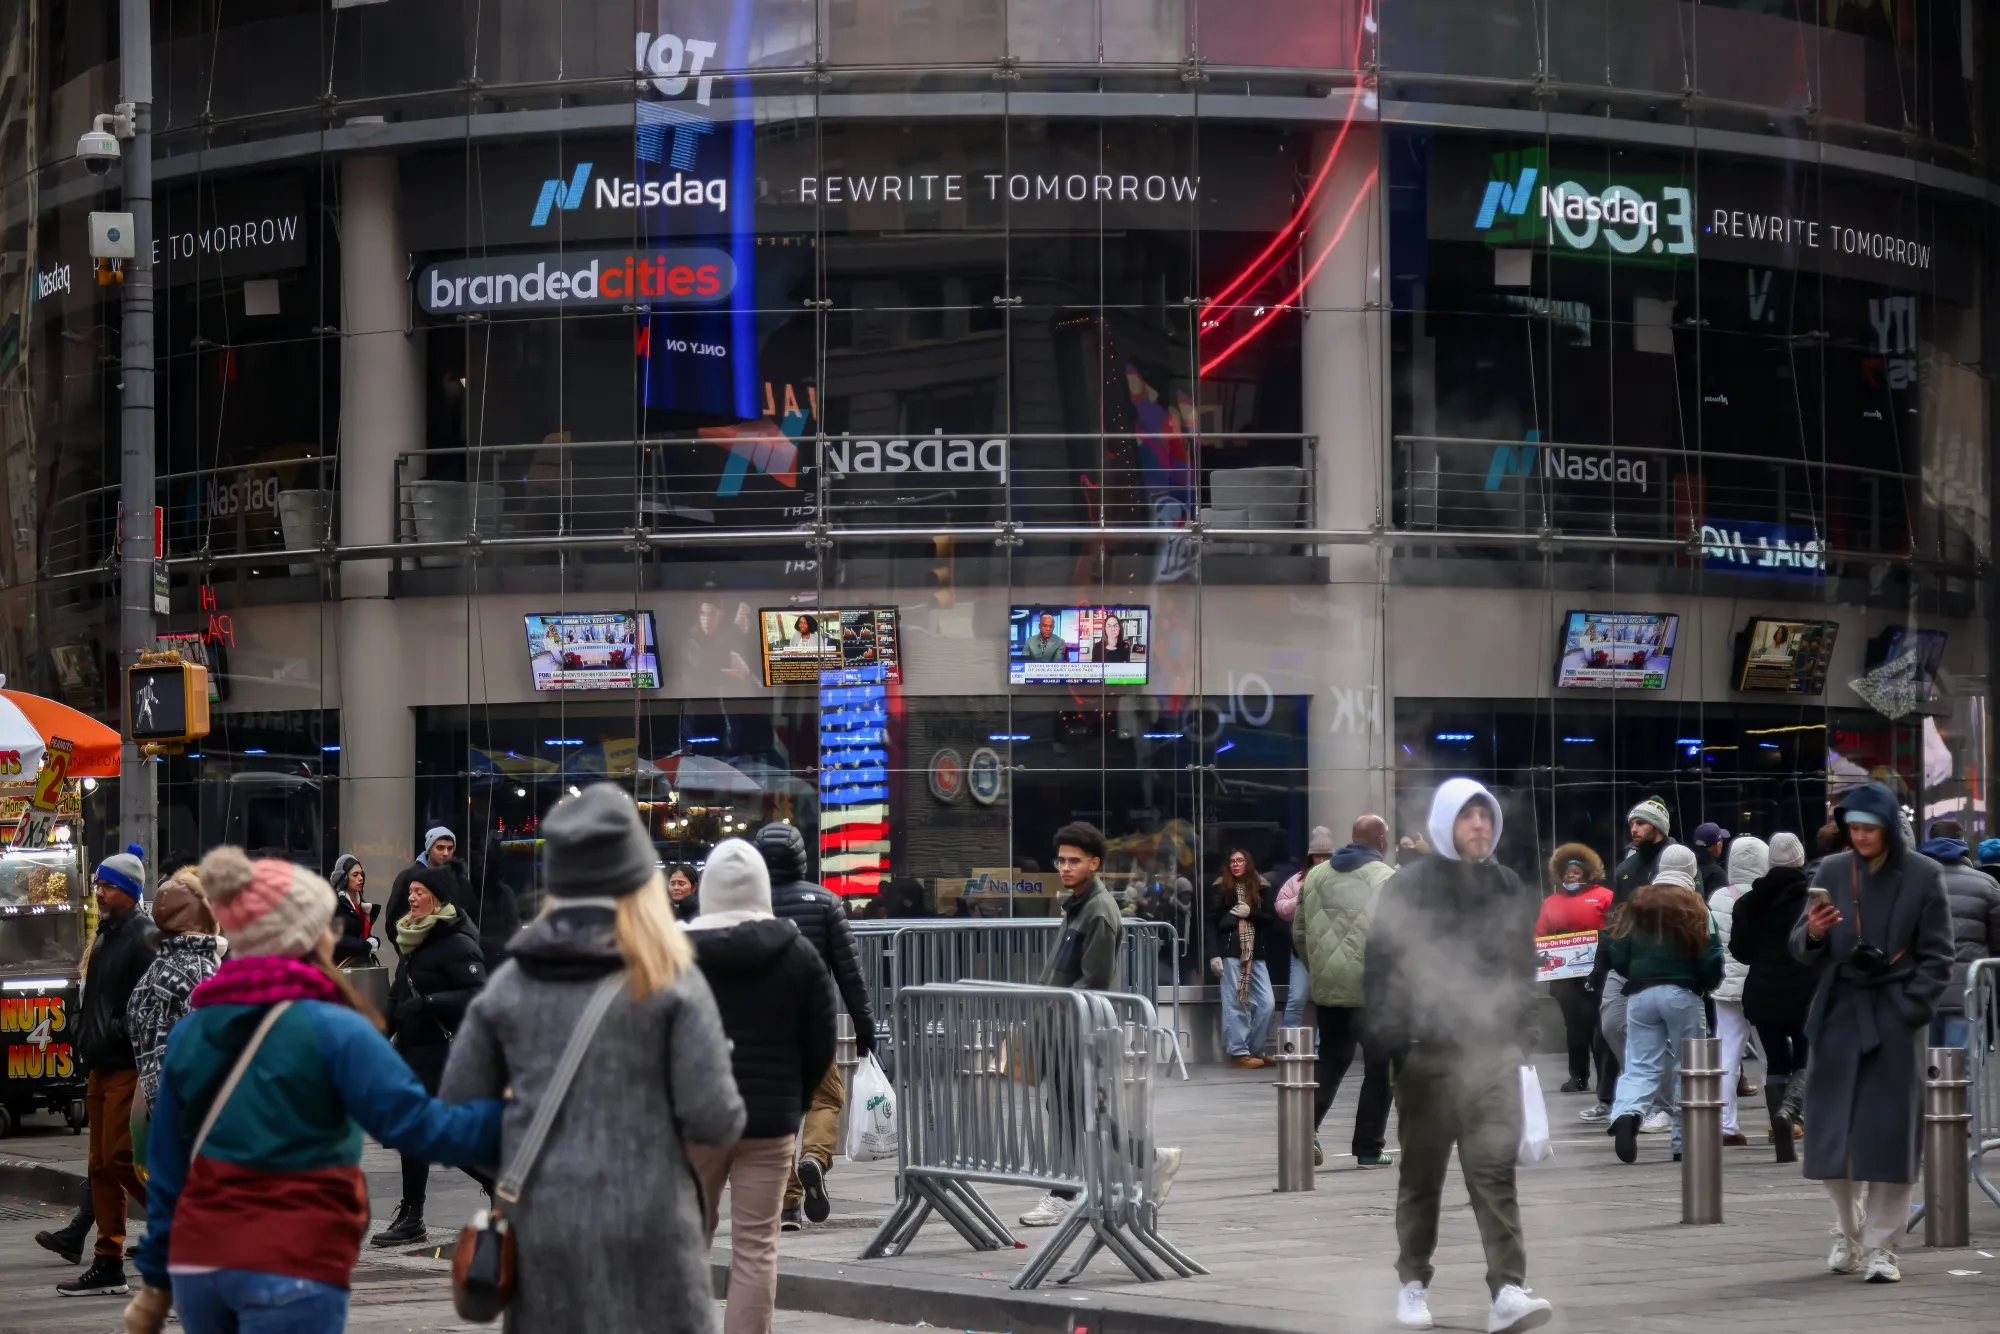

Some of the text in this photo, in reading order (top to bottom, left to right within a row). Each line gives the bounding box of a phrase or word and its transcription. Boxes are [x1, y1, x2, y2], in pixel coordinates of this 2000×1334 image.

[595, 173, 726, 213] Nasdaq
[801, 175, 1200, 202] REWRITE TOMORROW
[1540, 185, 1658, 234] Nasdaq
[170, 216, 298, 261] TOMORROW
[1713, 209, 1931, 269] REWRITE TOMORROW
[38, 261, 71, 301] Nasdaq
[430, 255, 721, 308] brandedcities
[817, 428, 1007, 484] Nasdaq
[1545, 447, 1648, 492] Nasdaq
[51, 738, 74, 752] PEANUTS
[1536, 940, 1558, 948] Hop-On
[1559, 937, 1582, 945] Hop-Off
[1, 996, 66, 1033] NUTS
[26, 1018, 53, 1052] 4
[8, 1043, 74, 1079] NUTS
